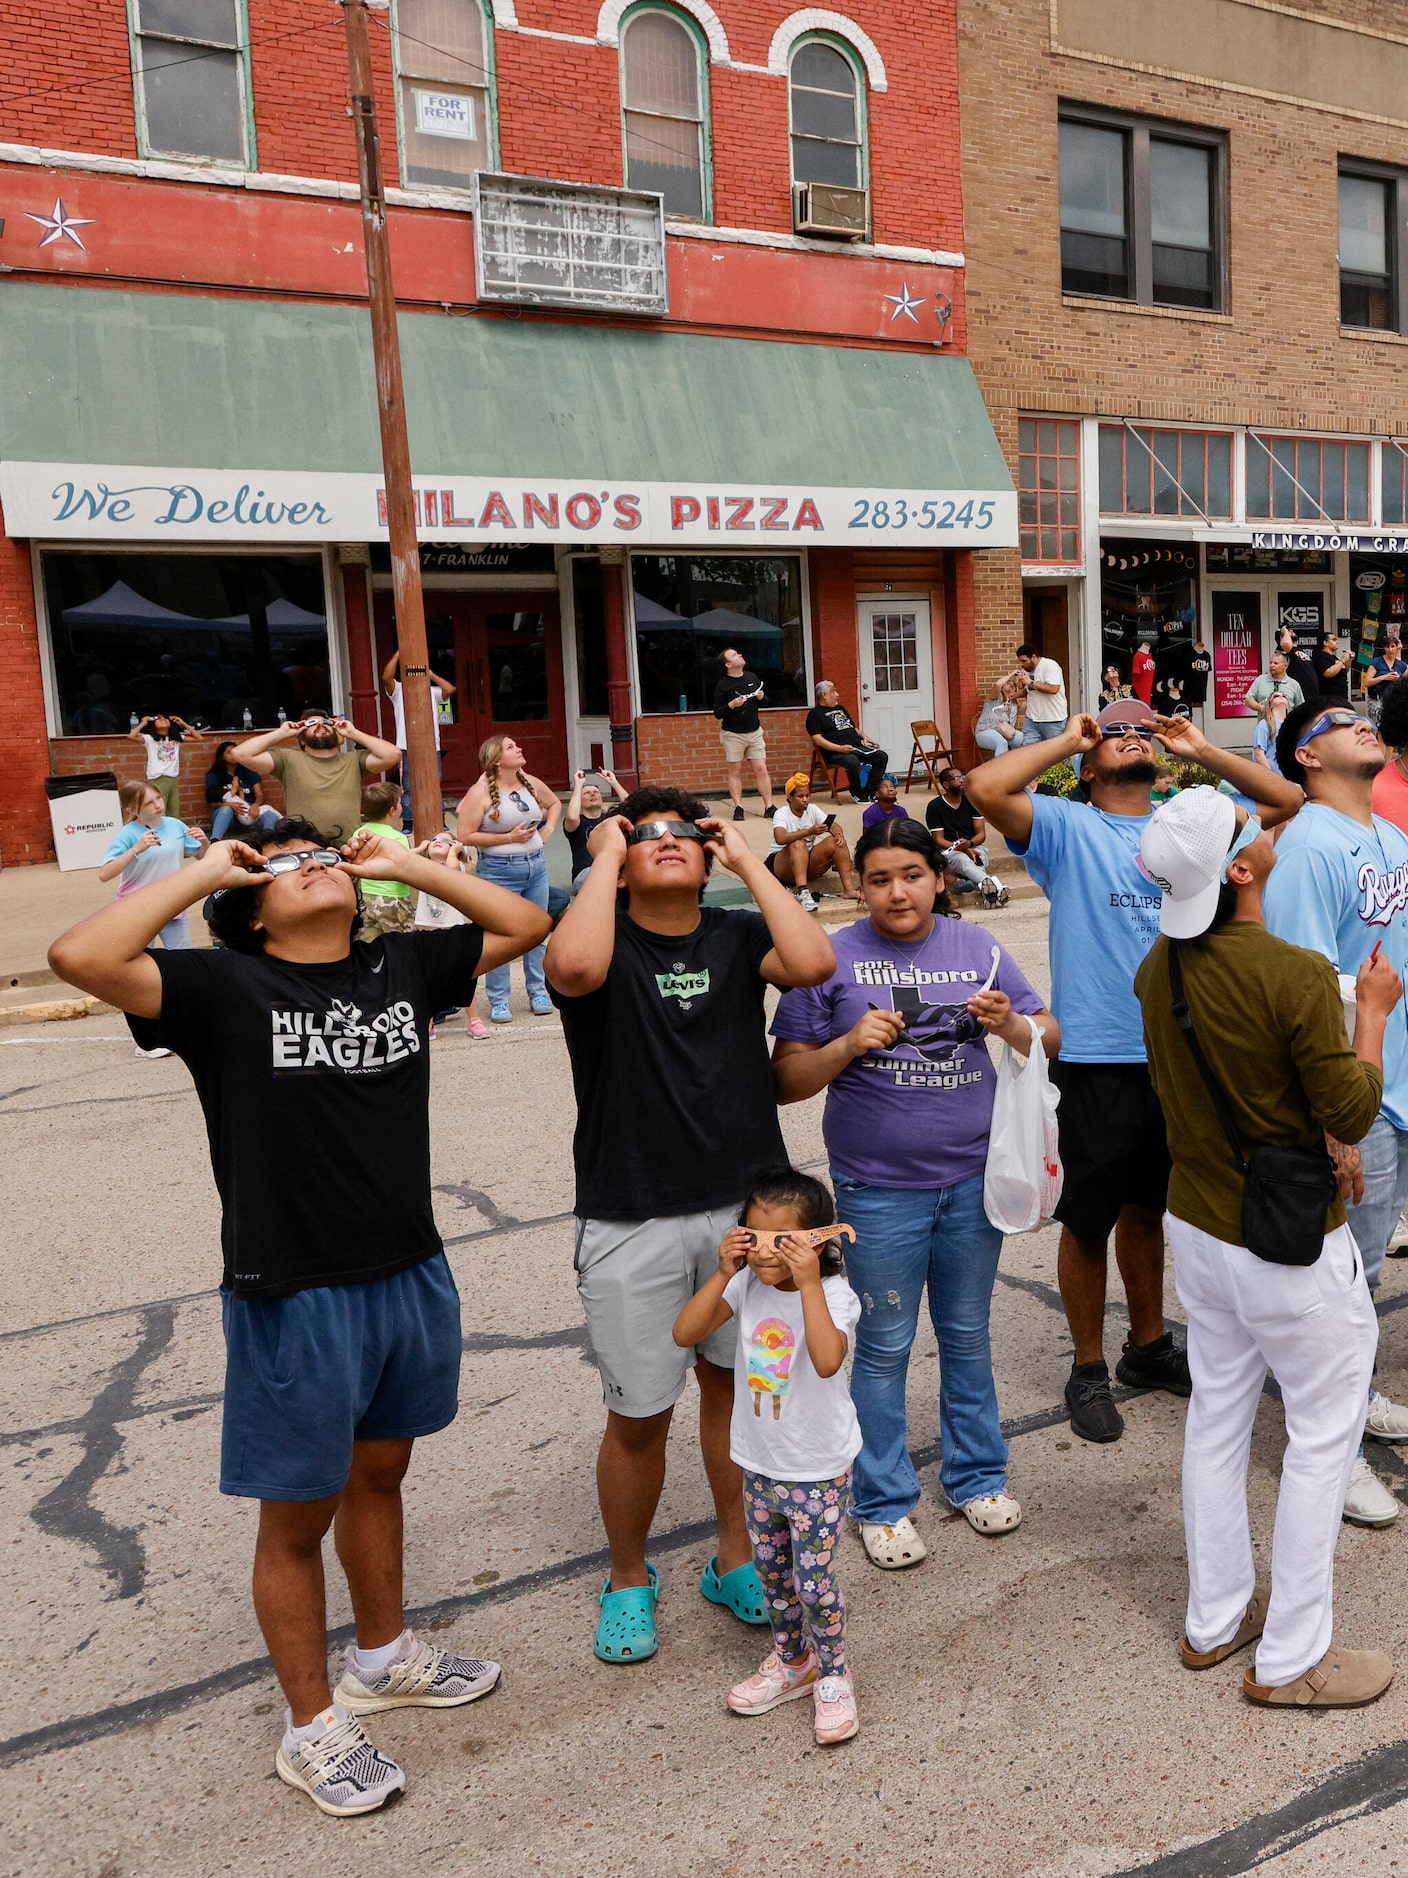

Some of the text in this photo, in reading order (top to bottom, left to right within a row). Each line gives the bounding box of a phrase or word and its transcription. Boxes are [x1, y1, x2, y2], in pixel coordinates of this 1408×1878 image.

[429, 97, 461, 110] FOR
[424, 107, 466, 120] RENT
[52, 482, 333, 525] We Deliver
[670, 495, 825, 532] PIZZA
[1254, 533, 1360, 551] KINGDOM
[419, 553, 510, 566] 7-FRANKLIN
[1227, 613, 1244, 630] TEN
[1280, 606, 1320, 623] KGS
[1220, 631, 1252, 648] DOLLAR
[1227, 649, 1247, 665] TEES
[77, 821, 114, 831] REPUBLIC
[1109, 893, 1162, 910] ECLIPS
[853, 960, 895, 970] 2015
[853, 968, 978, 986] Hillsboro
[272, 1021, 421, 1068] EAGLES
[344, 1067, 382, 1075] FOOTBALL
[895, 1070, 983, 1090] League
